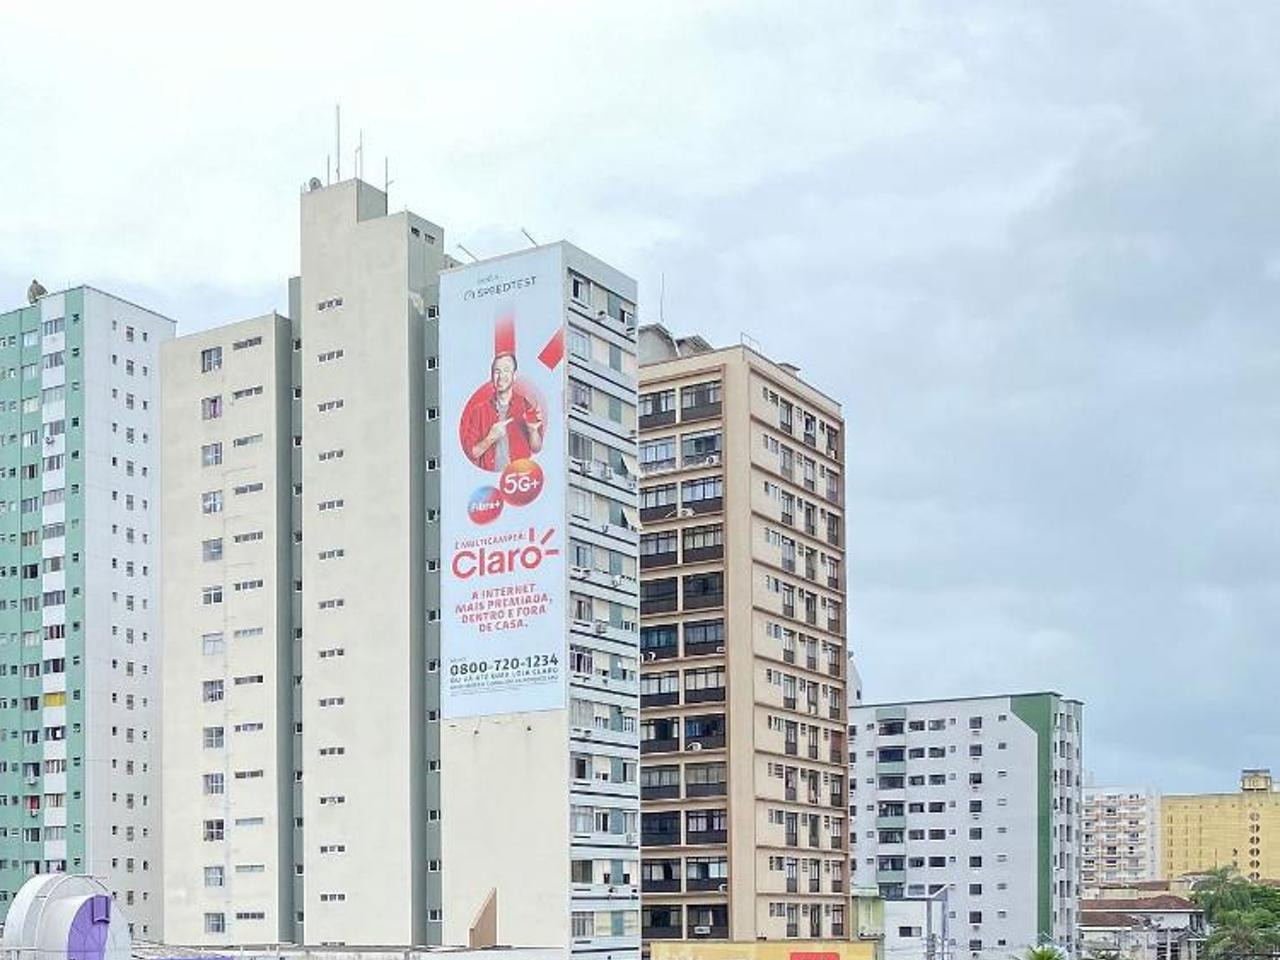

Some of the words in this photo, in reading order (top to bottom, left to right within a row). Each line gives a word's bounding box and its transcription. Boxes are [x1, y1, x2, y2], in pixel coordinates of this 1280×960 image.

[504, 472, 540, 494] 5G+
[452, 546, 542, 579] Claro
[472, 591, 479, 600] A
[482, 583, 536, 600] INTERNET
[455, 601, 485, 613] MAIS
[461, 611, 505, 623] DENTRO
[508, 609, 514, 619] E
[516, 605, 546, 617] FORA
[479, 623, 493, 633] DE
[450, 653, 559, 676] 0800-720-1234
